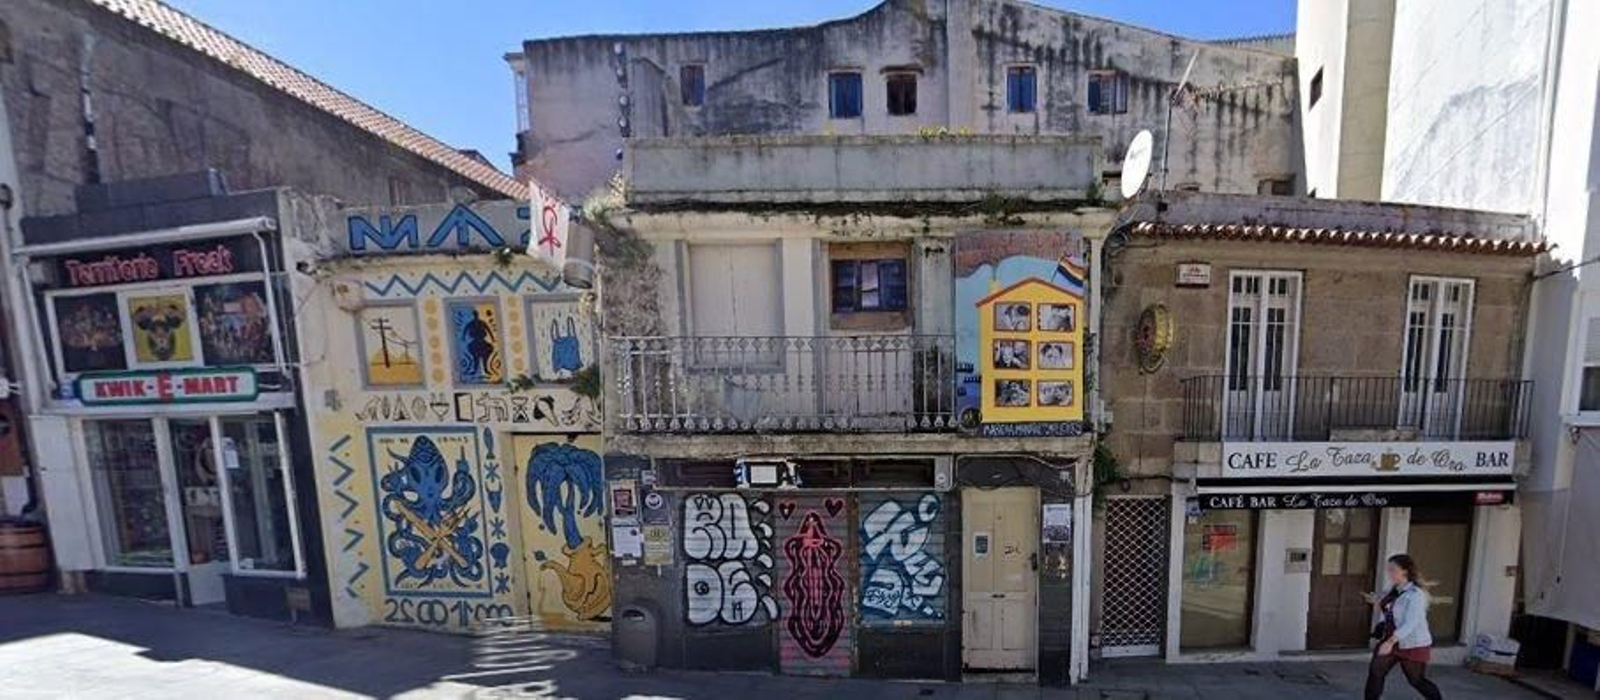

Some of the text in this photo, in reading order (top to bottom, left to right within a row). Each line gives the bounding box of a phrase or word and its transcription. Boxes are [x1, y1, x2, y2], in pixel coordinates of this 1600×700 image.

[65, 244, 234, 285] Territorio Freak
[1228, 447, 1509, 472] CAFE La Taza de Oro BAR
[1210, 495, 1244, 508] CAFÉ
[1250, 496, 1277, 508] BAR
[1345, 494, 1358, 507] de
